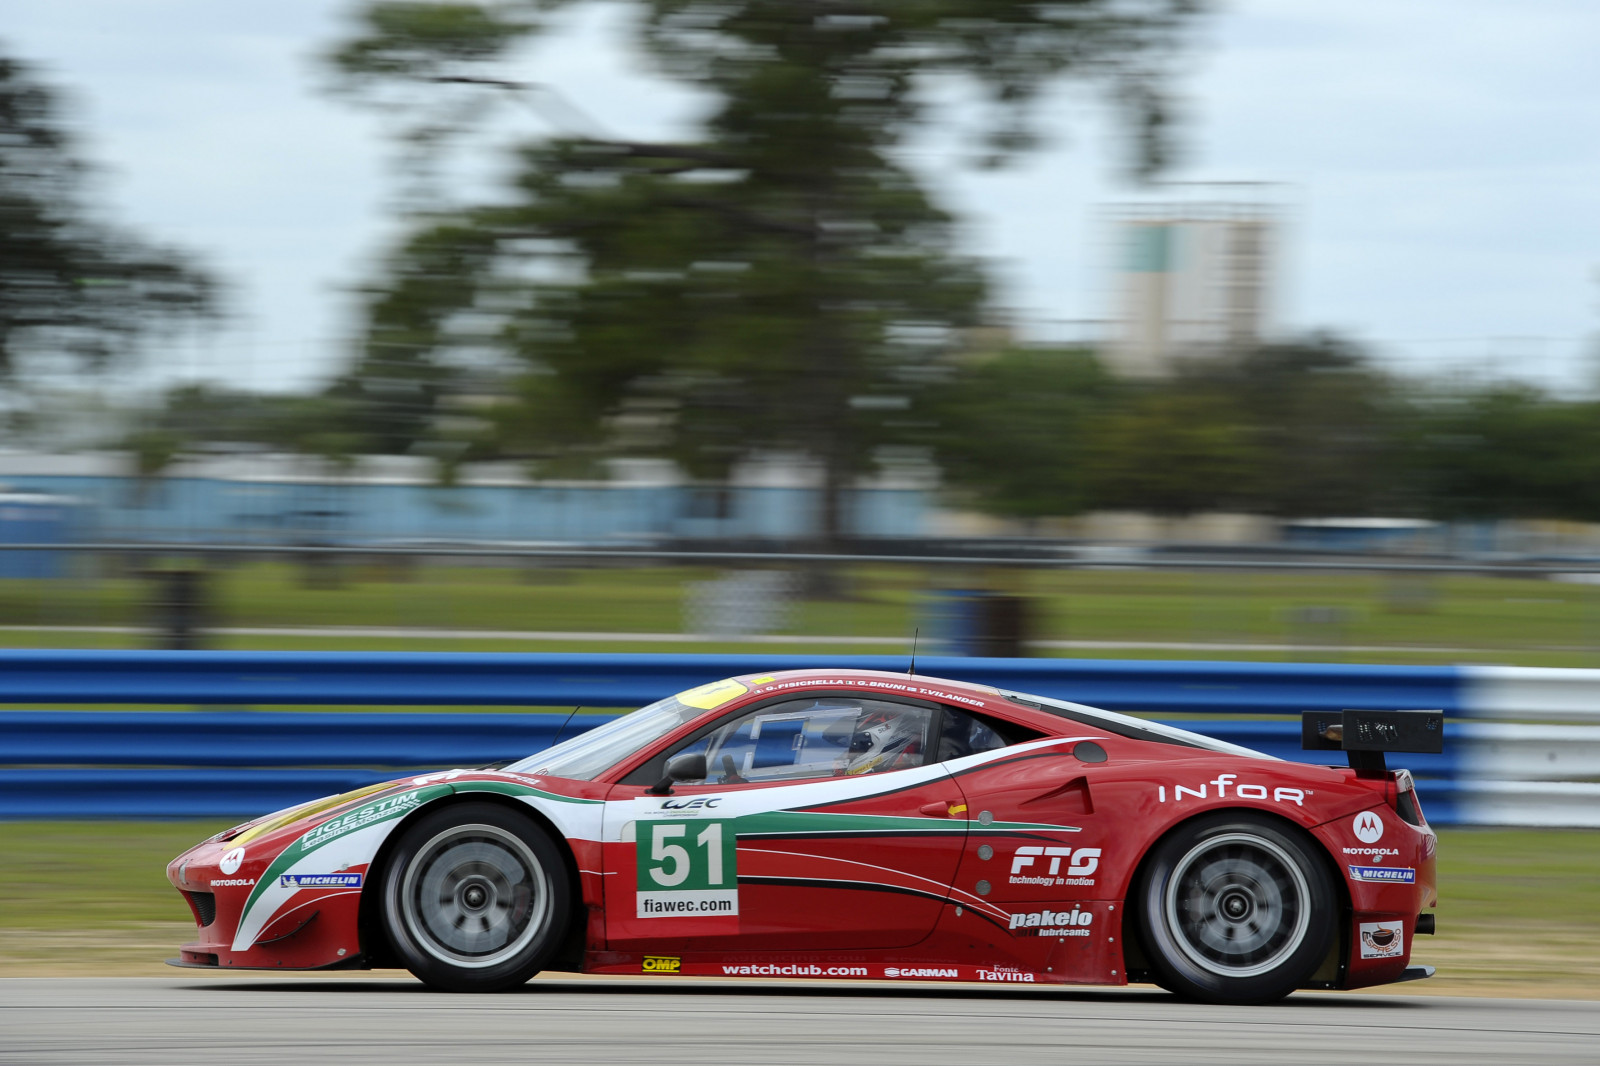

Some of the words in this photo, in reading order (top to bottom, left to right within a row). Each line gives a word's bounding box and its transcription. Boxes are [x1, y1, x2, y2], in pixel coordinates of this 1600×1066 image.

[919, 688, 985, 707] T.VILANDER
[660, 798, 722, 810] WEC
[301, 791, 419, 843] FIGESTIM
[649, 823, 723, 887] 51
[1342, 847, 1399, 855] MOTOROLA
[1010, 846, 1102, 876] FTS
[299, 876, 358, 885] MICHELIN
[1362, 870, 1414, 879] MICHELIN
[210, 878, 255, 887] MOTOROLA
[1009, 875, 1055, 887] technology
[1055, 876, 1064, 885] in
[1065, 877, 1095, 886] motion
[643, 899, 732, 912] fiawec.com
[1008, 909, 1094, 930] pakelo
[1039, 928, 1091, 937] lubricants
[1362, 929, 1401, 953] ESPRESSO
[642, 959, 681, 971] OMP
[722, 964, 868, 976] watchclub.com
[900, 968, 959, 978] GARMAN
[975, 969, 1035, 982] Tavina
